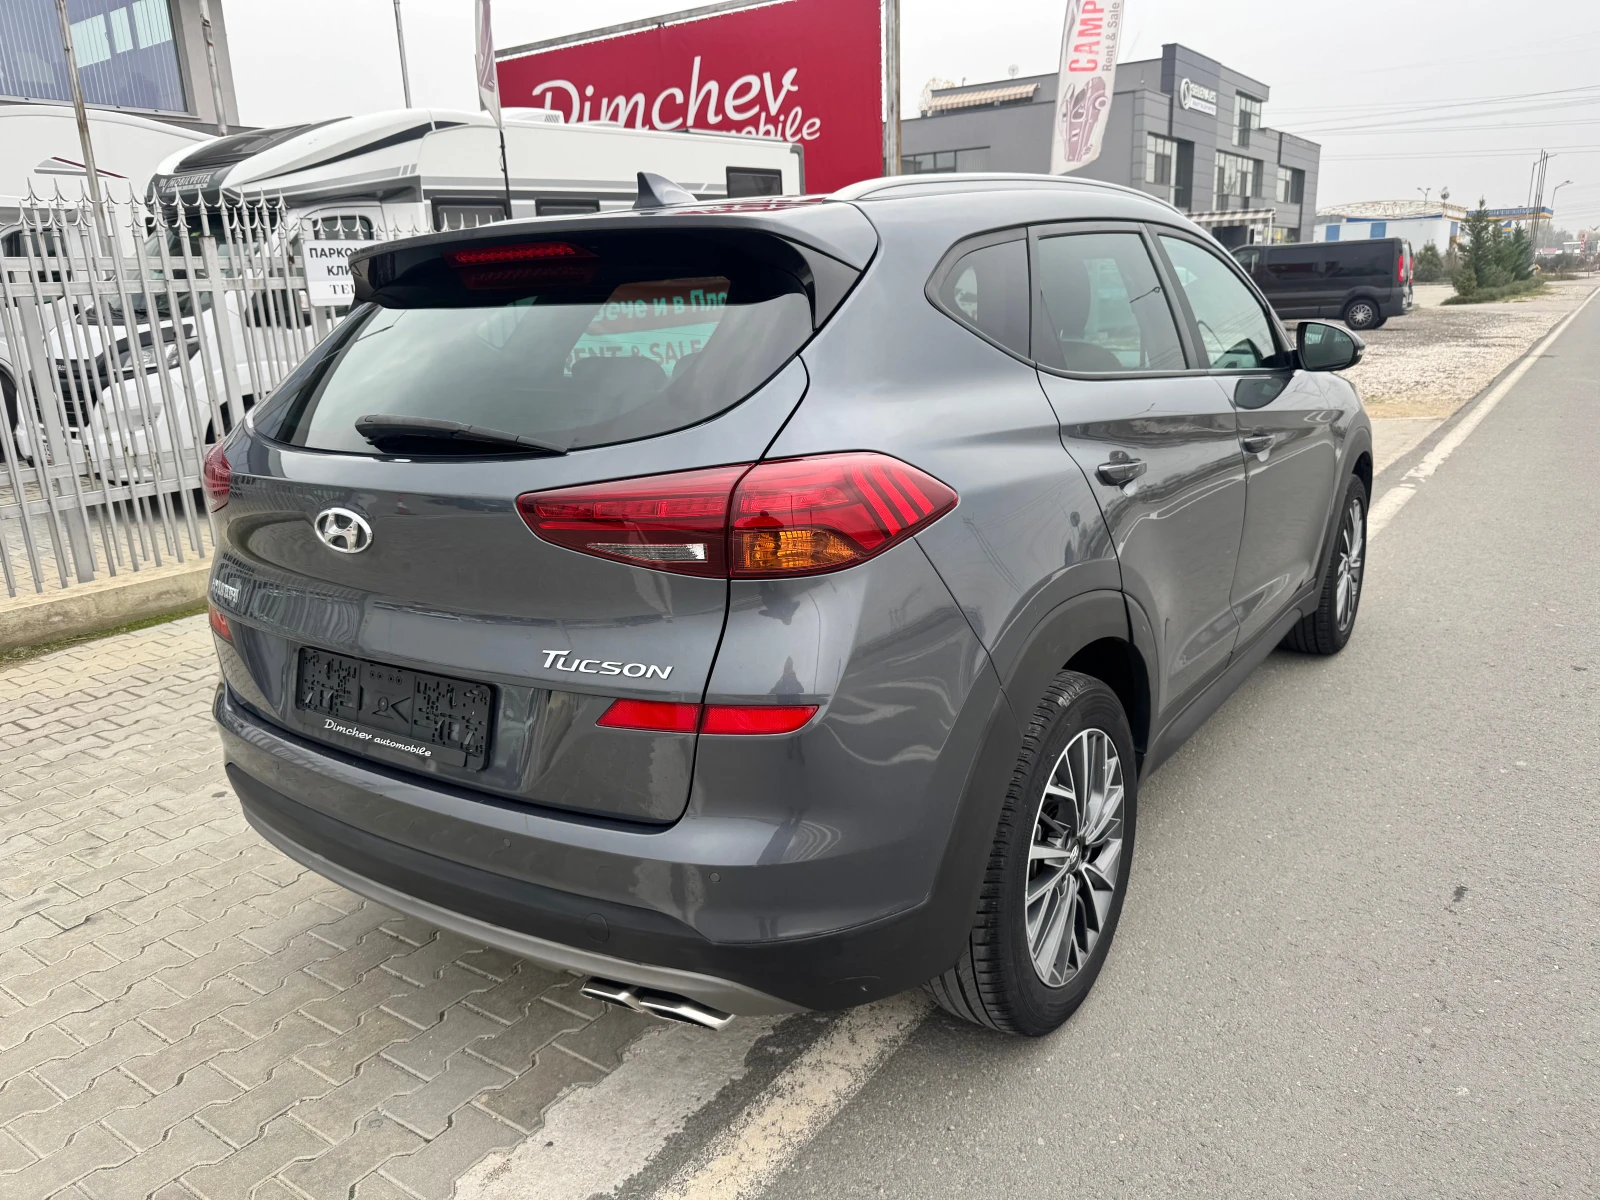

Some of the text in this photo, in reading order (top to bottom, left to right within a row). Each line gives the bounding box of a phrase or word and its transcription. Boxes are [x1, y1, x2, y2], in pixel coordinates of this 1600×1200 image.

[1068, 0, 1104, 72] CAMP
[1102, 2, 1120, 71] Rent & Sale
[532, 56, 798, 131] Dimchev
[309, 247, 358, 259] ПАРКО
[324, 718, 432, 757] Dimchev automobile
